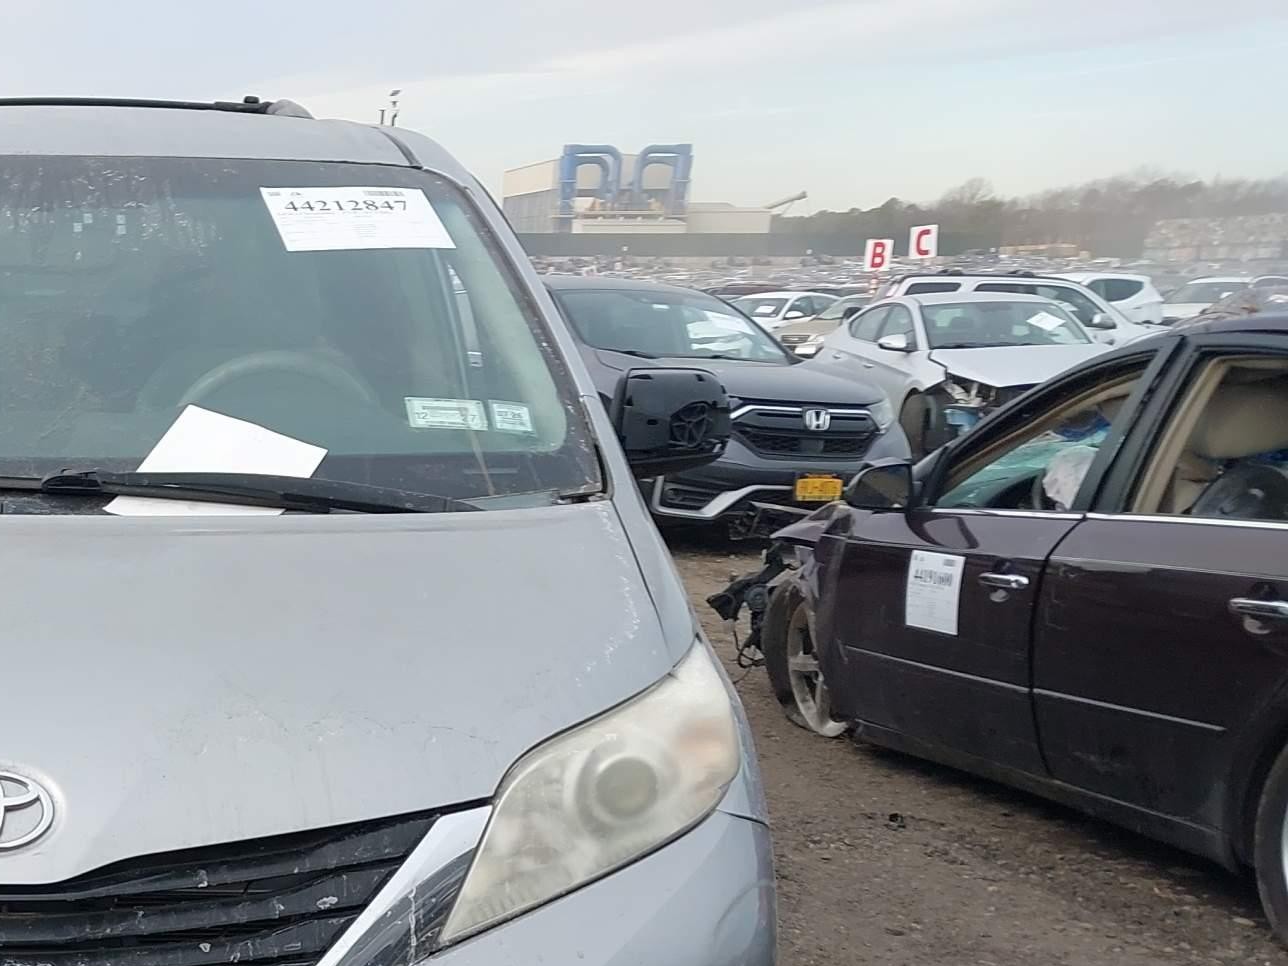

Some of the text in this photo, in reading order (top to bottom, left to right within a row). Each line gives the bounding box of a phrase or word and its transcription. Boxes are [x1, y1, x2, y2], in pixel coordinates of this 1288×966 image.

[284, 199, 408, 213] 44212847
[870, 241, 886, 268] B
[916, 228, 932, 256] C
